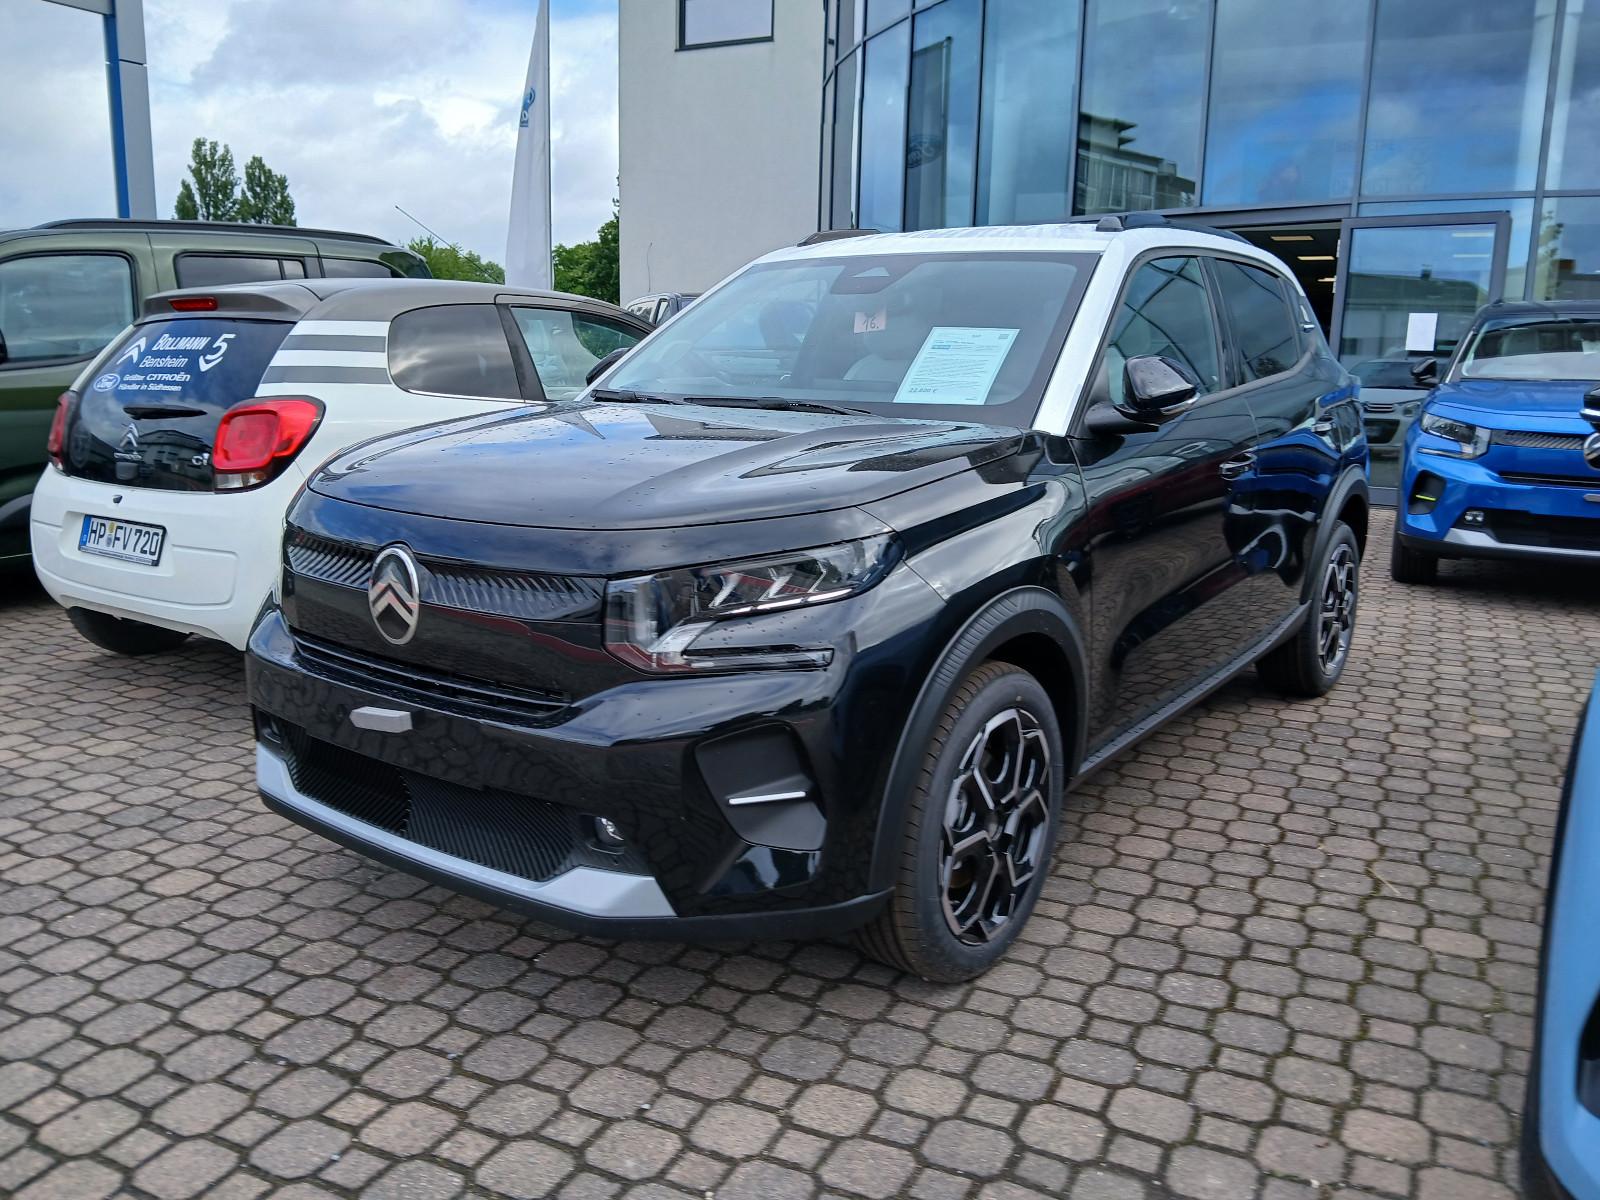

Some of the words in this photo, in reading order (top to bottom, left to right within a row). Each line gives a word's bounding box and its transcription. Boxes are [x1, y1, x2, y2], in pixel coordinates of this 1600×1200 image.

[152, 334, 212, 351] BOLLMANN
[139, 356, 189, 368] Bensheim
[89, 521, 107, 545] HP
[113, 526, 133, 550] FV
[134, 529, 160, 556] 720
